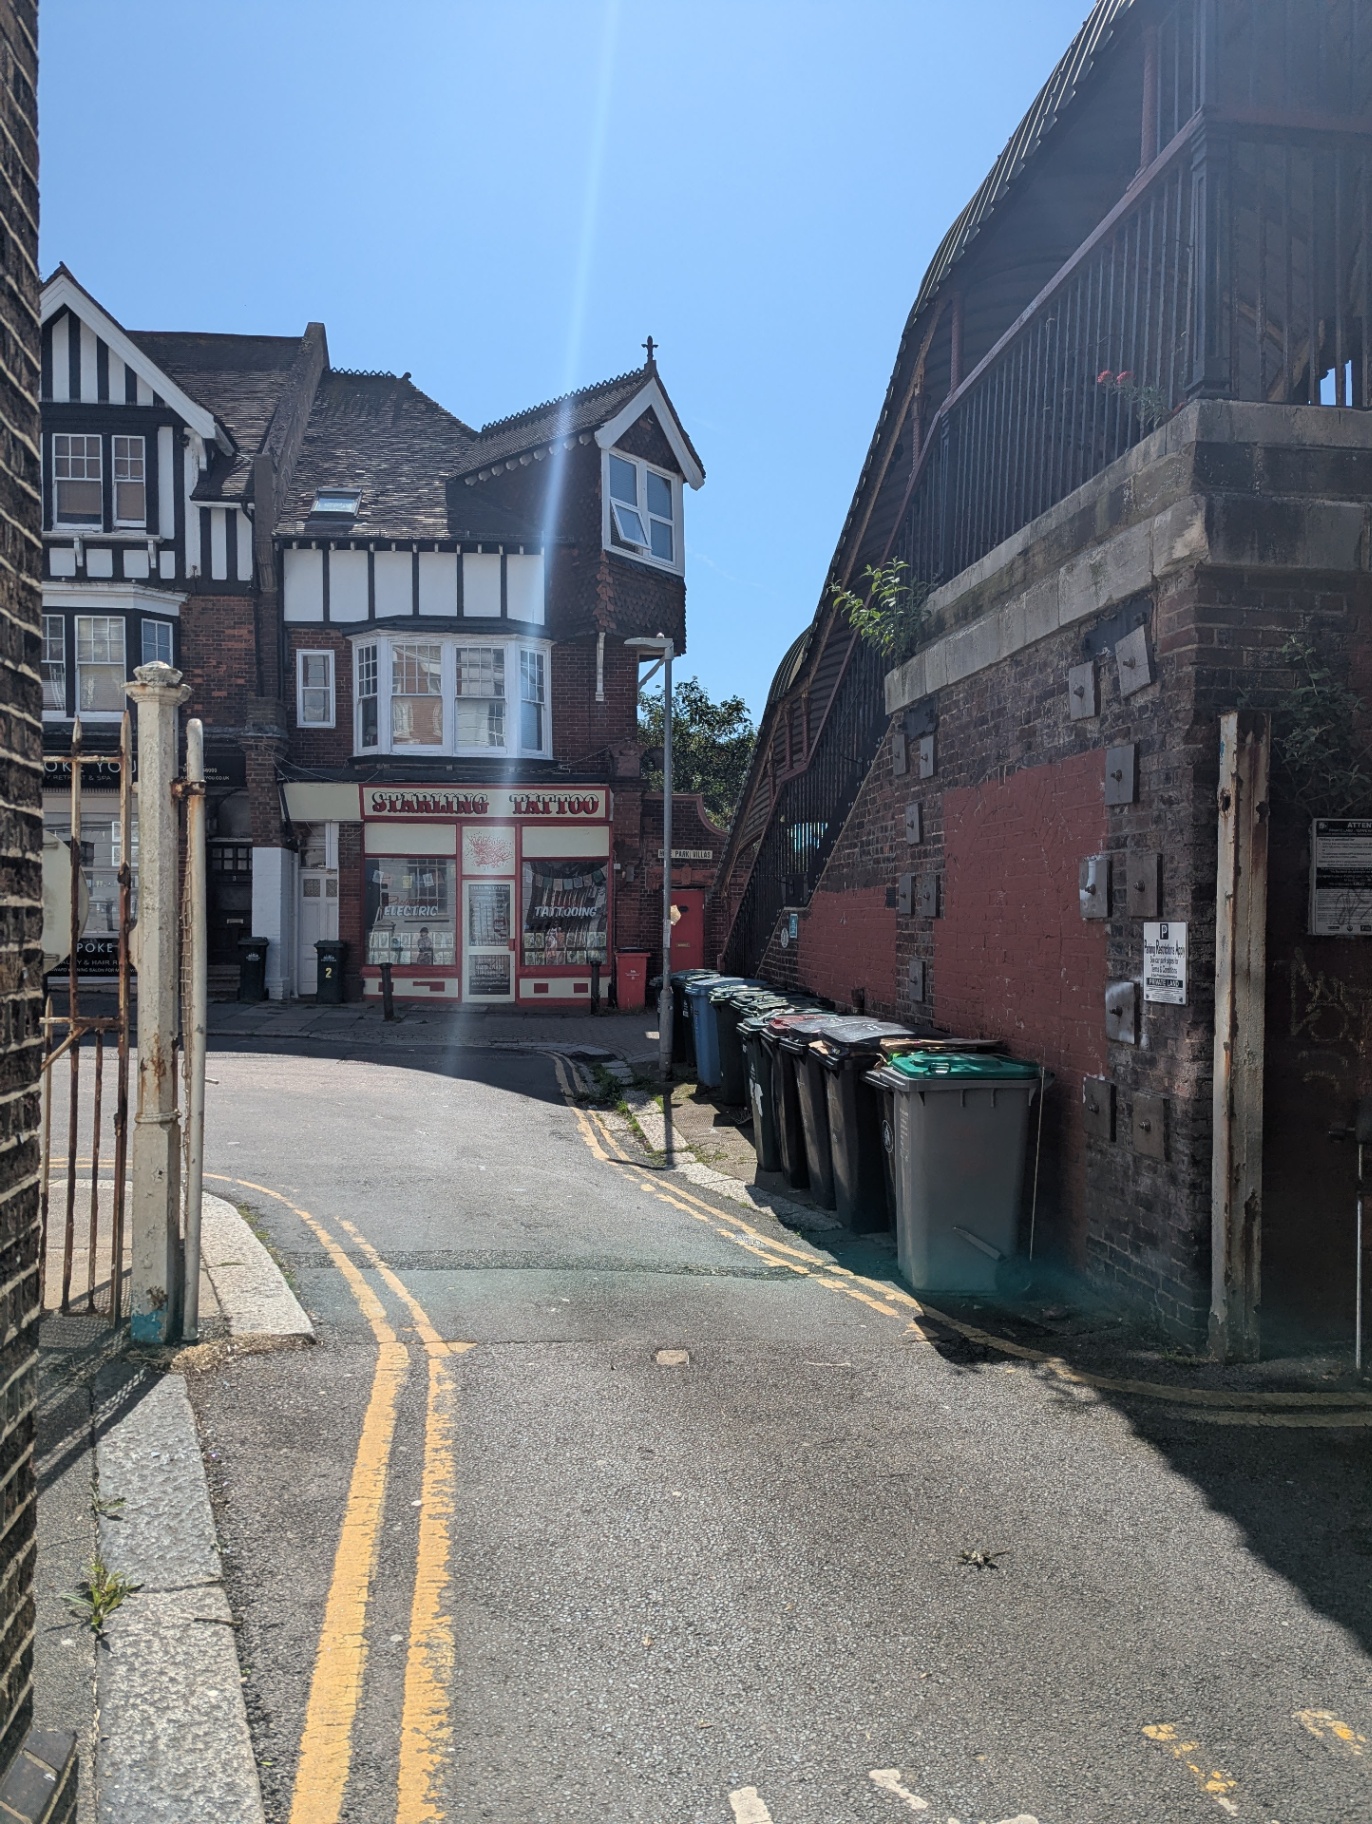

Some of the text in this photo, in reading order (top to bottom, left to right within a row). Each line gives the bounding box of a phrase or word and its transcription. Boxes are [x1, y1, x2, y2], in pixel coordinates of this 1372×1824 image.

[372, 791, 600, 815] STARLING TATTOO
[674, 850, 690, 858] PARK
[692, 850, 711, 858] VILLAS
[384, 905, 438, 917] ELECTRIC
[534, 906, 598, 918] TATTOOING
[76, 942, 113, 953] POKE
[1144, 939, 1156, 957] Parking
[325, 967, 332, 979] 2
